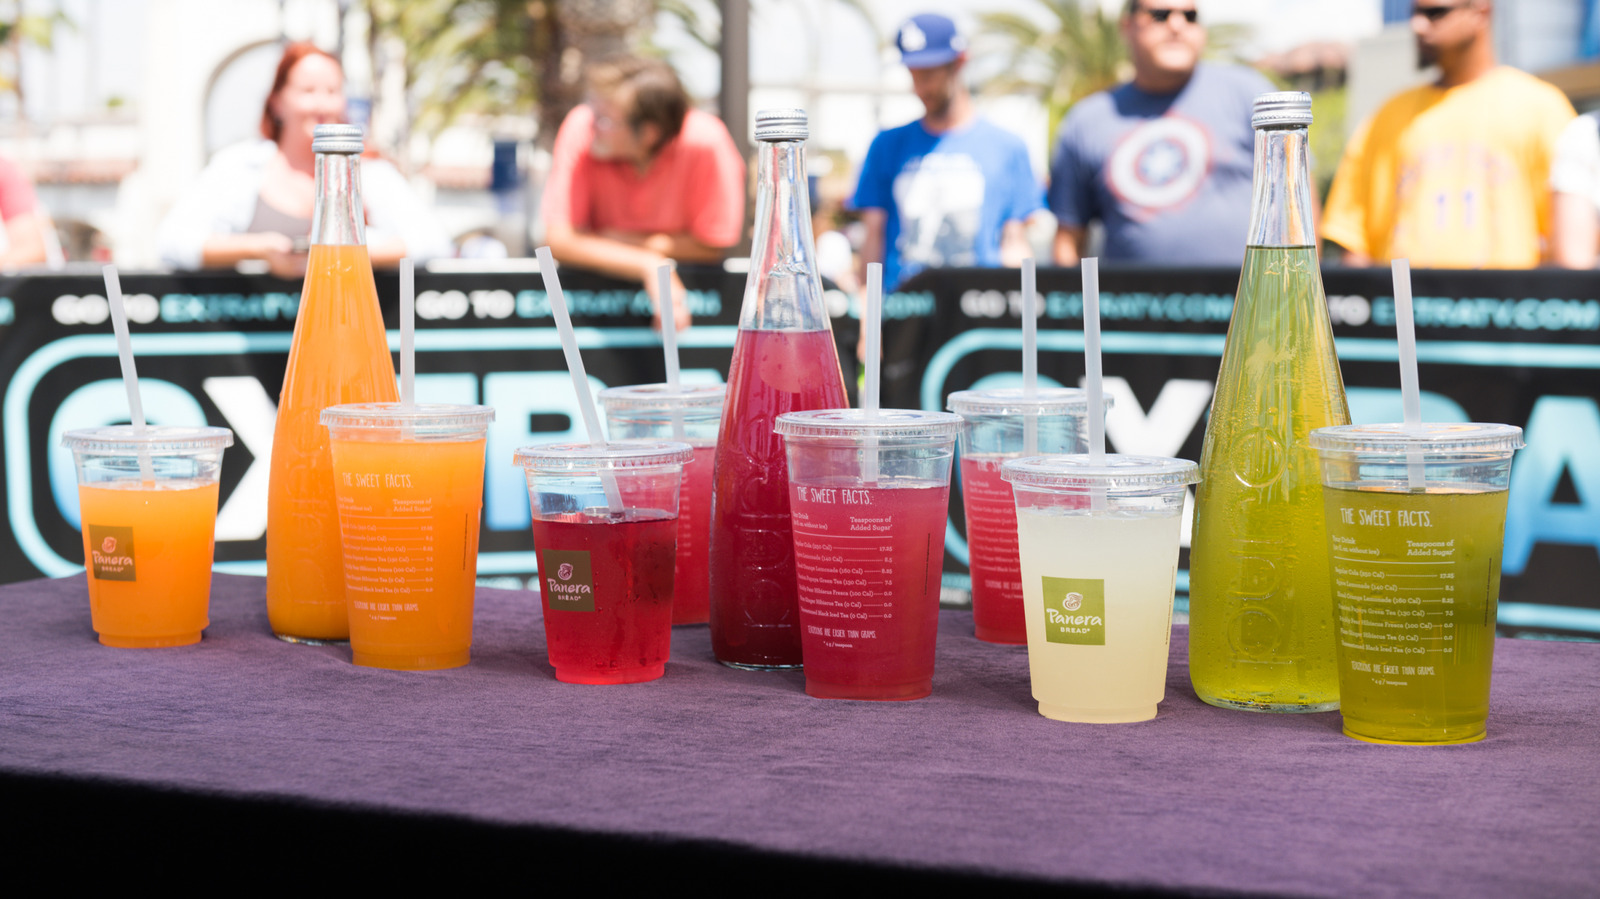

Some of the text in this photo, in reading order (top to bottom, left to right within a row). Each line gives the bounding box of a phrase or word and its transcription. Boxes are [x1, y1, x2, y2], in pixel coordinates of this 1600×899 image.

[415, 290, 469, 320] GO
[469, 289, 515, 318] TO
[960, 289, 1006, 319] GO
[342, 472, 414, 488] THE SWEET FACTS.
[797, 486, 872, 505] THE SWEET FACTS.
[392, 499, 424, 507] Teaspoons
[849, 515, 892, 524] Teaspoons of
[1340, 508, 1433, 527] THE SWEET FACTS.
[1406, 539, 1455, 548] Teaspoons of
[92, 550, 132, 566] Panera
[851, 567, 863, 575] Cal)
[1372, 571, 1385, 579] Cal)
[547, 578, 591, 594] Panera
[1371, 583, 1384, 591] (140
[1384, 584, 1398, 592] Cal)
[1393, 597, 1406, 605] (160
[1407, 597, 1421, 605] Cal)
[1046, 608, 1102, 626] Panera
[1419, 622, 1433, 630] Cal)
